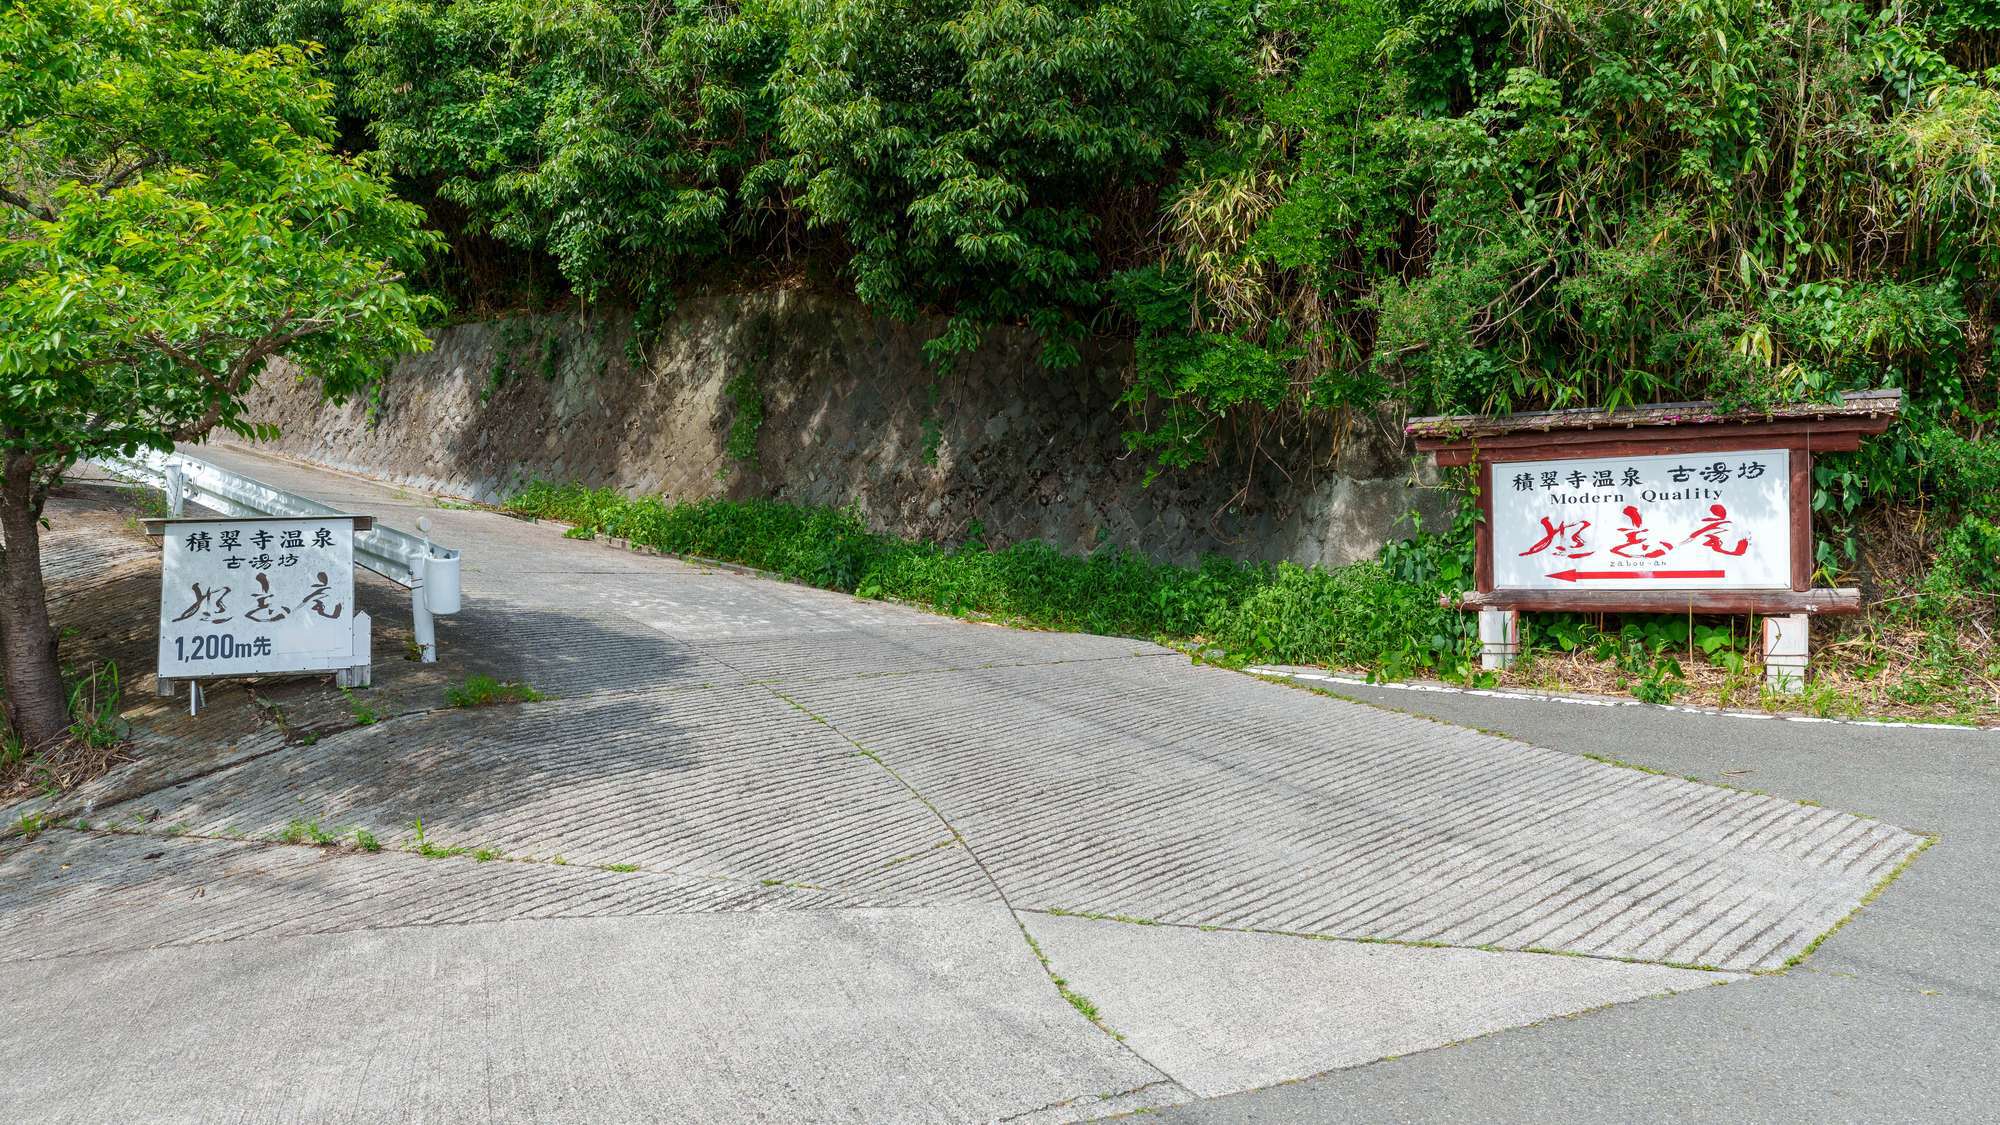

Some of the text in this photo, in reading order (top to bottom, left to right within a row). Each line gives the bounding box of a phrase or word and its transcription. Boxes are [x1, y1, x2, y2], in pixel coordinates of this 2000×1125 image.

[1512, 461, 1766, 492] 積翠寺温泉 古湯坊
[1550, 487, 1724, 505] Modern Quality
[185, 527, 336, 552] 積翠寺温泉
[222, 554, 299, 570] 古湯坊
